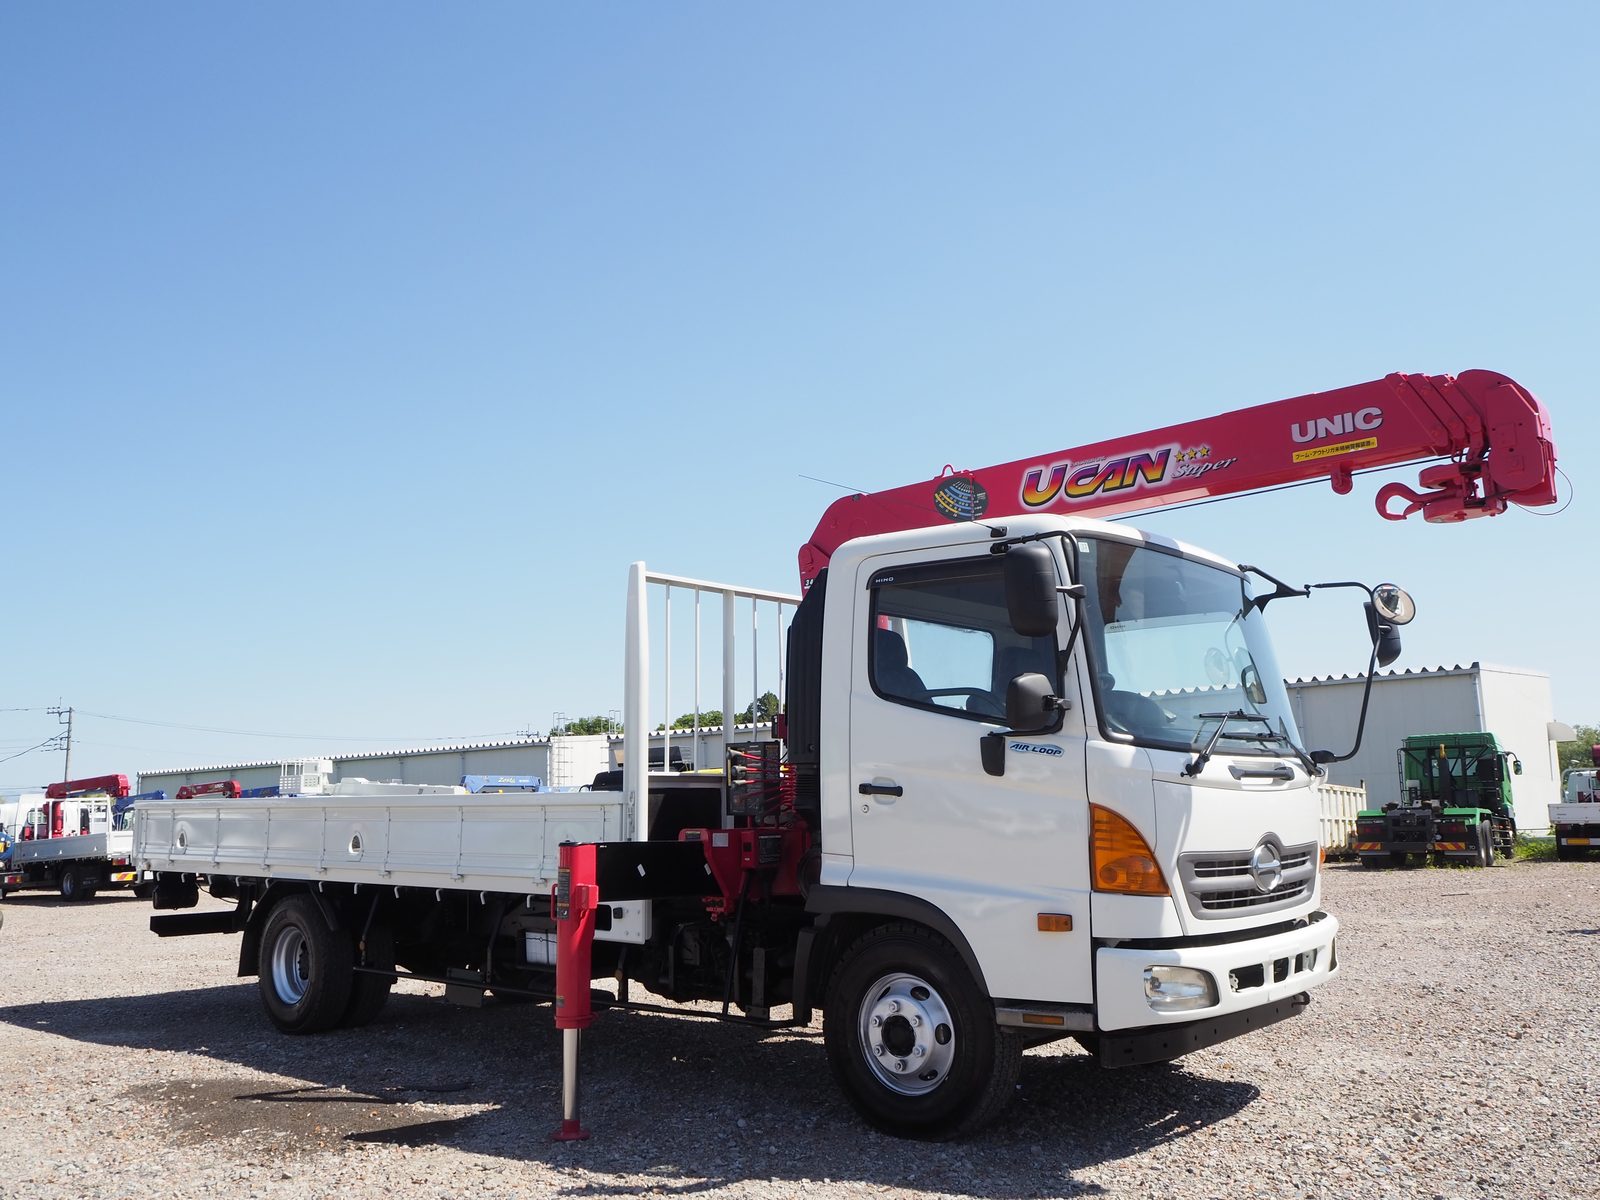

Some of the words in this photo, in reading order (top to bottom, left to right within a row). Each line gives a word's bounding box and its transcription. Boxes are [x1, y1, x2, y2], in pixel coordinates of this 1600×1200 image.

[1291, 407, 1382, 443] UNIC
[1022, 448, 1172, 507] UCAN
[1171, 457, 1237, 479] Super
[1010, 743, 1030, 751] AIR
[1031, 746, 1062, 755] LOOP
